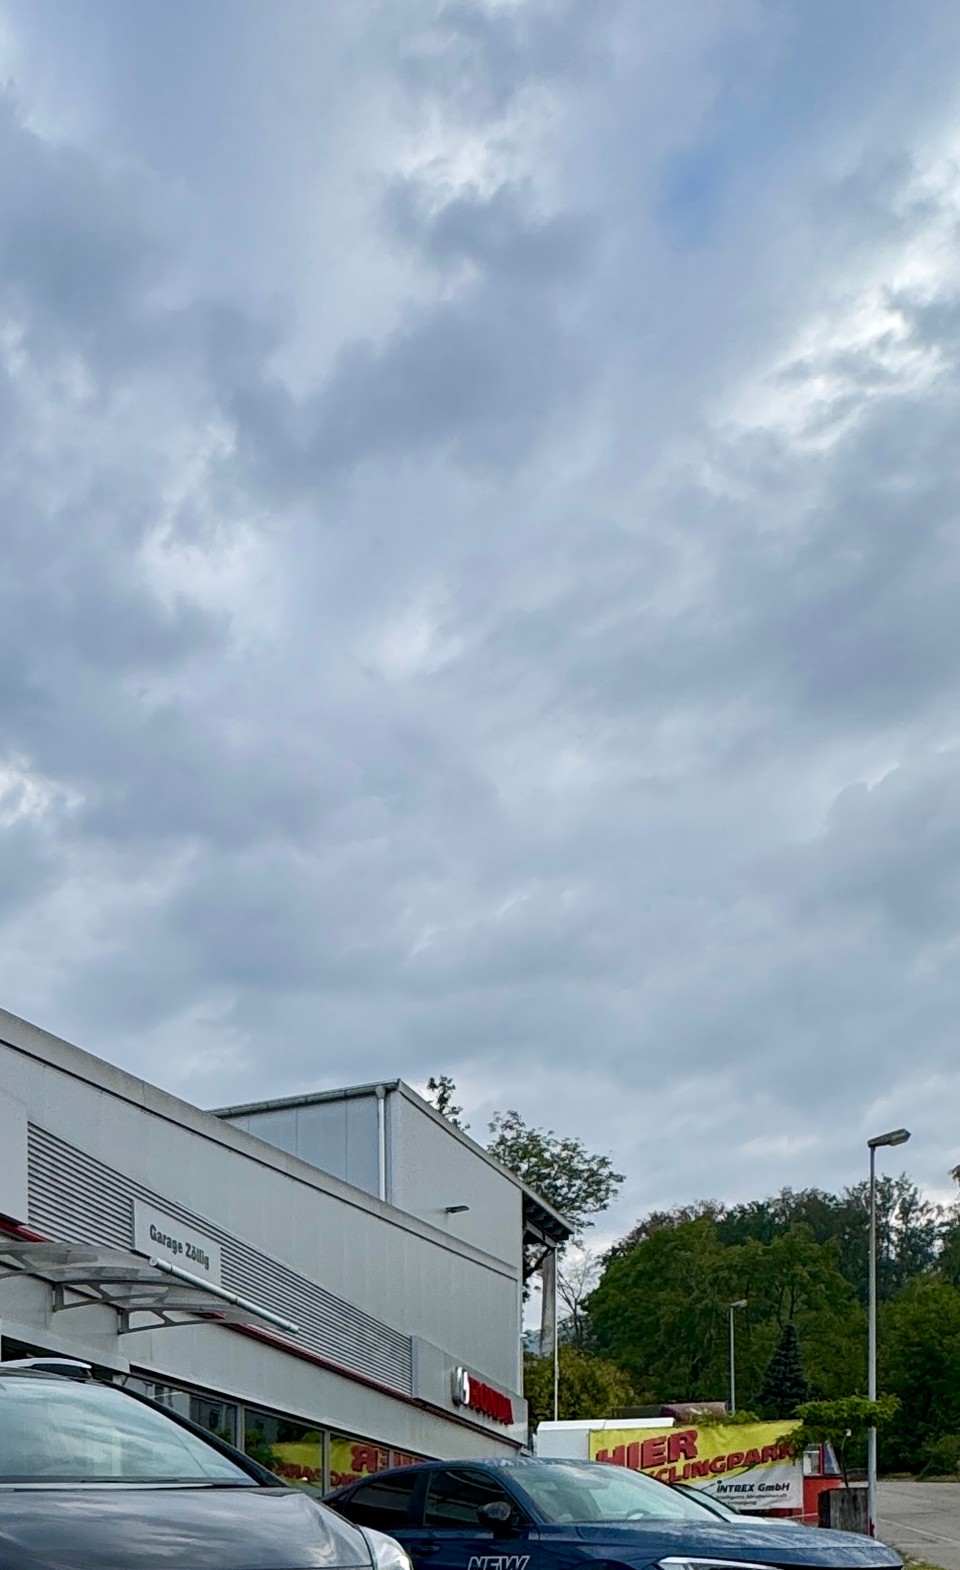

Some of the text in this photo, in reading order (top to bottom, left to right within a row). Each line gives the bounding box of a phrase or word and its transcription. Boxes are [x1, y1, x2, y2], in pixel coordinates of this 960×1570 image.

[149, 1224, 209, 1270] Garage Zöllig
[595, 1429, 699, 1470] HIER
[652, 1444, 796, 1484] CLINGPARK
[757, 1483, 791, 1492] GmbH
